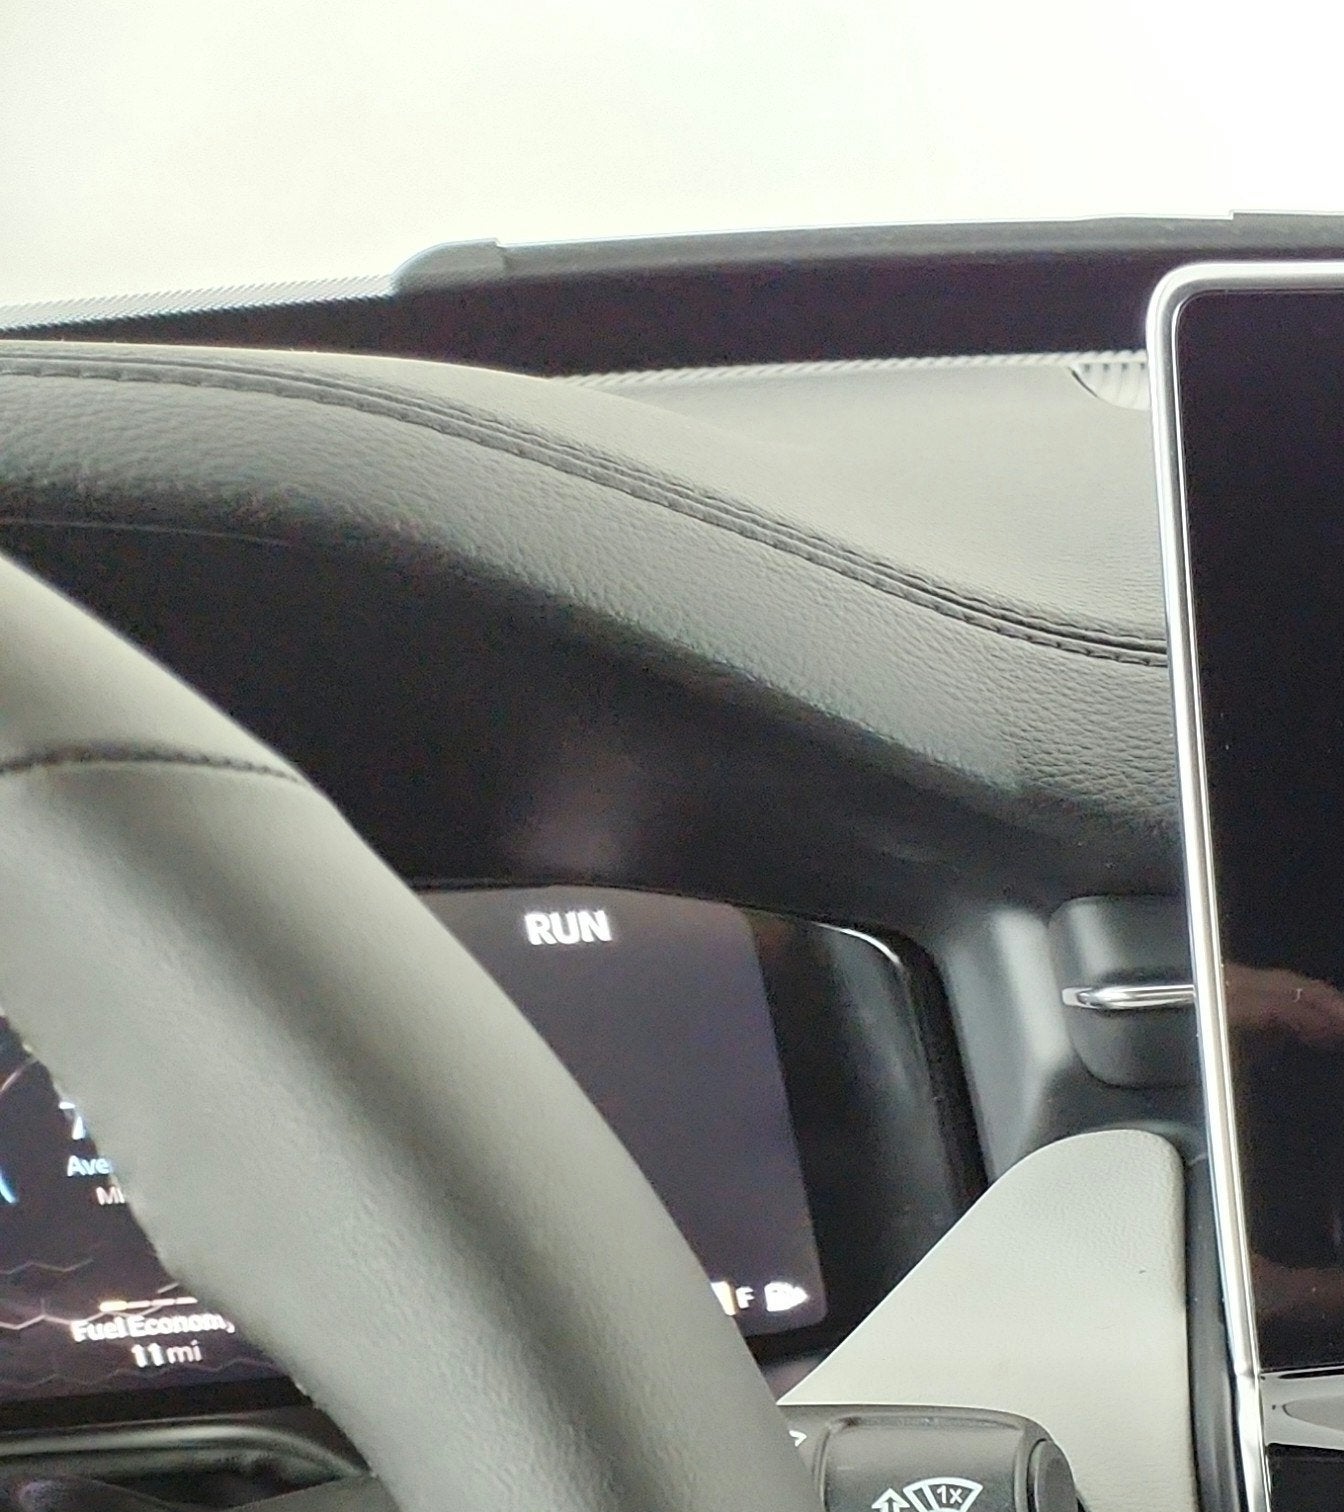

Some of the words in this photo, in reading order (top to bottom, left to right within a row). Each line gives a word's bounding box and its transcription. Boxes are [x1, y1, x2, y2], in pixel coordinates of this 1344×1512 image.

[524, 910, 612, 947] RUN
[67, 1155, 112, 1177] Ave
[735, 1286, 755, 1309] F
[70, 1316, 124, 1342] Fuel
[131, 1343, 164, 1368] 11
[167, 1339, 202, 1364] mi
